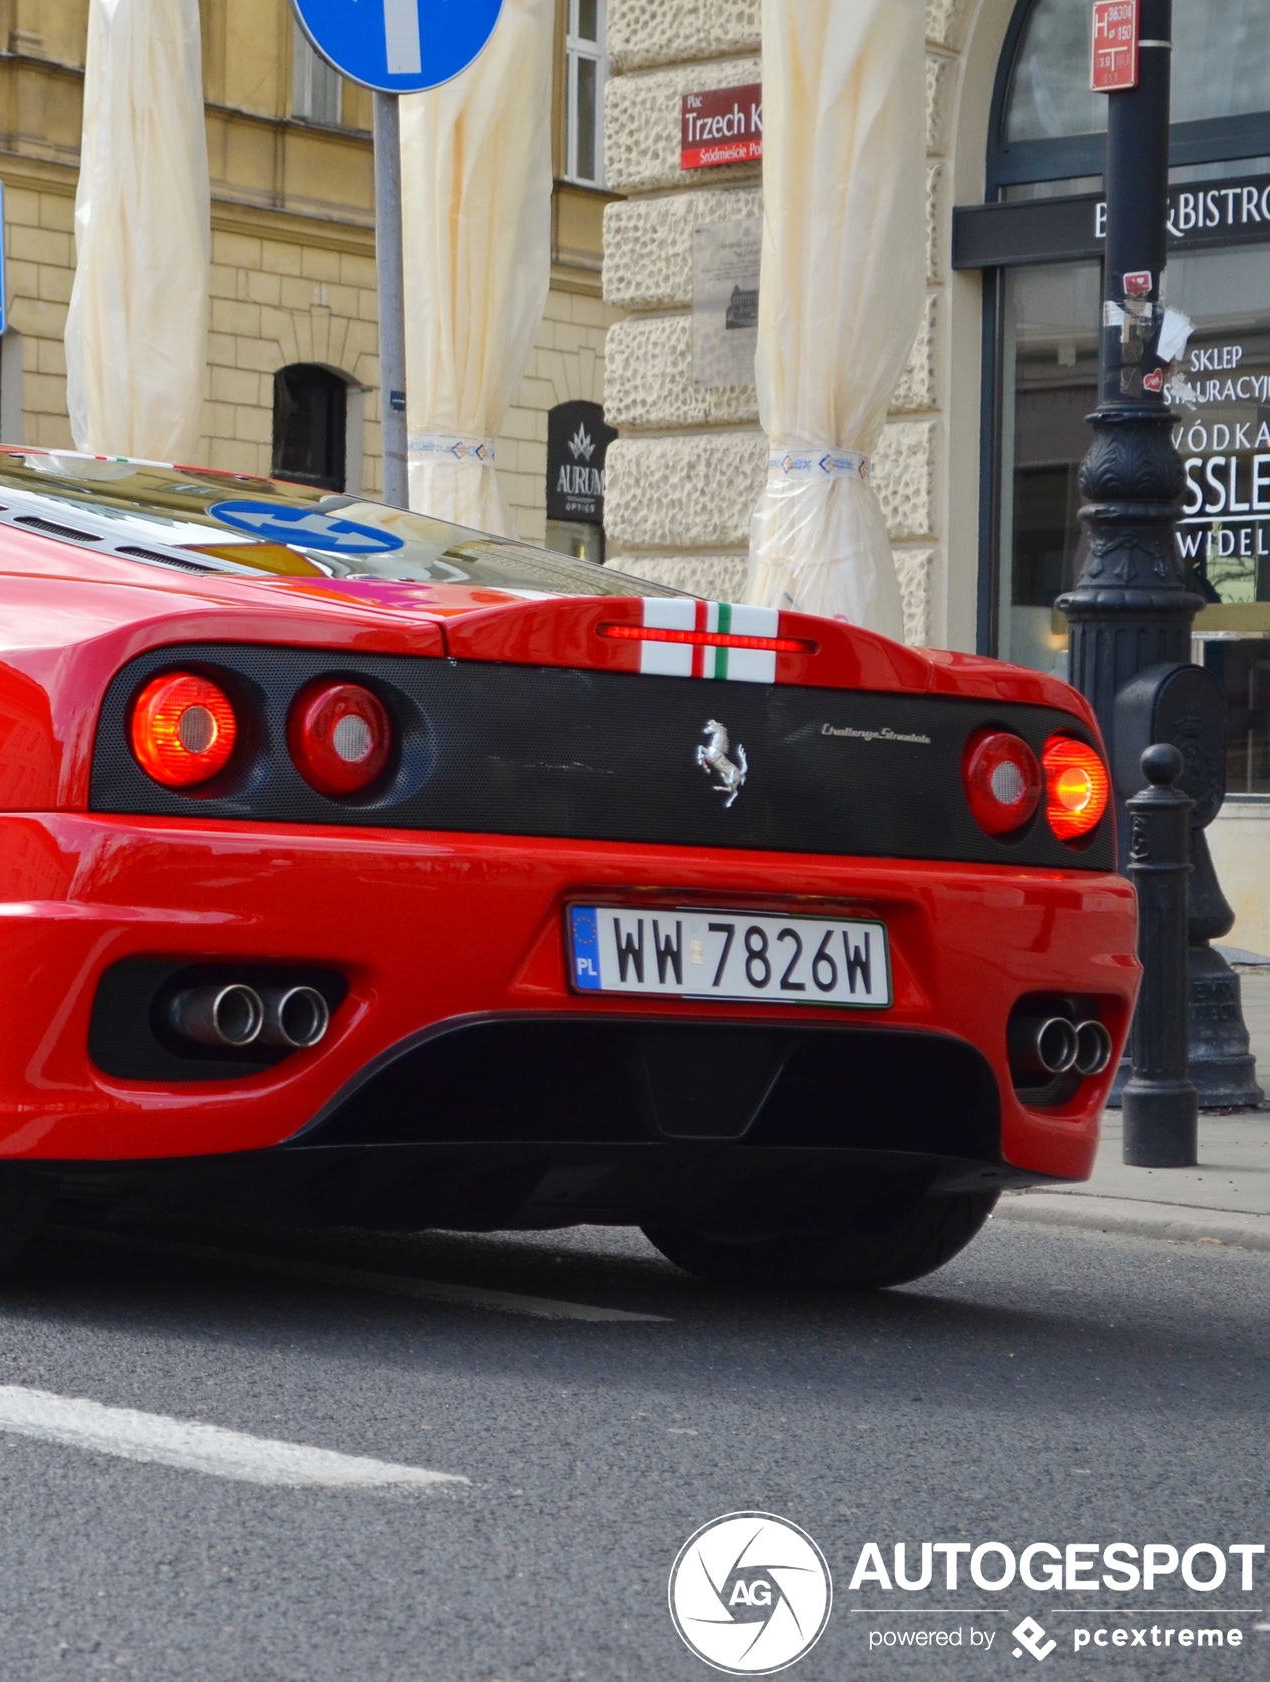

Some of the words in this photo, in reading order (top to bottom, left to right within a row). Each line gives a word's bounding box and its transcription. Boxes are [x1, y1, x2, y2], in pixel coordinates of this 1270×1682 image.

[687, 95, 703, 108] Plac
[685, 103, 745, 142] Trzech
[700, 145, 747, 163] Śródmieście
[1190, 345, 1243, 372] SKLEP
[557, 465, 606, 496] AURUM
[577, 957, 598, 977] PL
[613, 917, 684, 985] WW
[707, 922, 873, 995] 7826W
